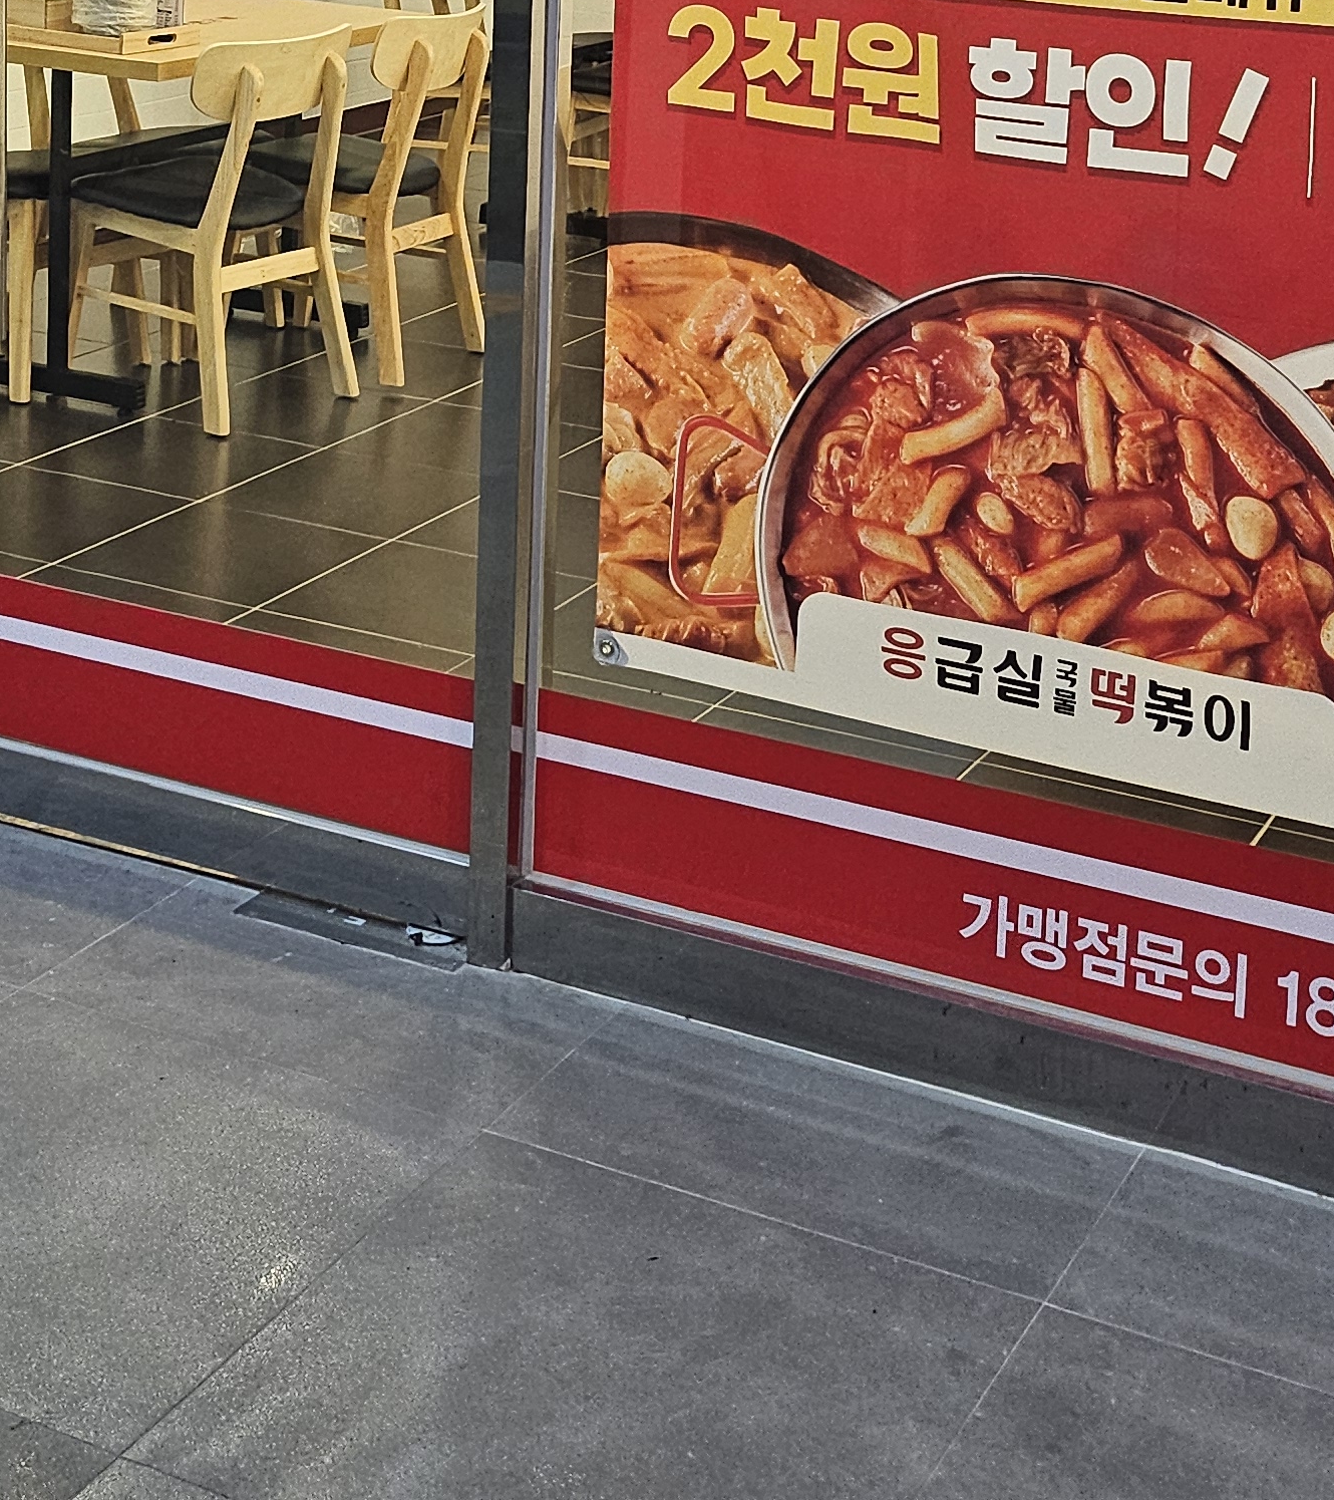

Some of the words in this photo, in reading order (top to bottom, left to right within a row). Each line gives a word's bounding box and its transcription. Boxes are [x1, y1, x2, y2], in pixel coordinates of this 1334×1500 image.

[667, 4, 942, 145] 2천원
[968, 37, 1270, 181] 할인!
[958, 892, 1250, 1020] 가맹점문의
